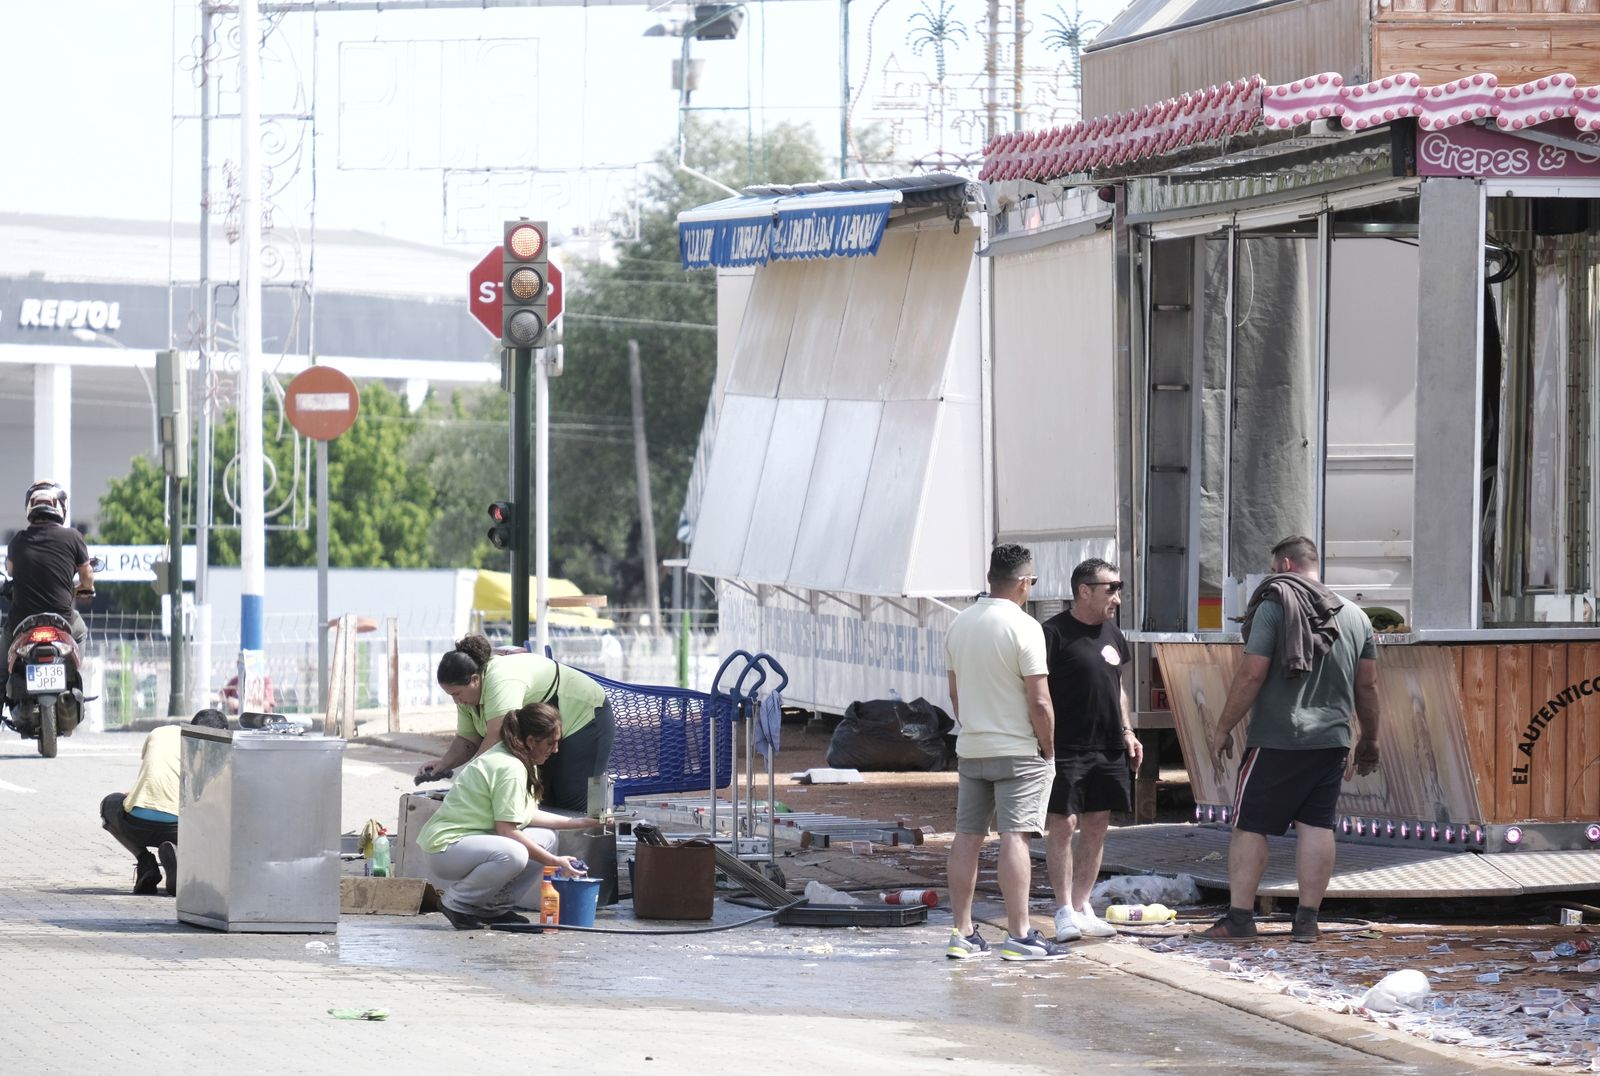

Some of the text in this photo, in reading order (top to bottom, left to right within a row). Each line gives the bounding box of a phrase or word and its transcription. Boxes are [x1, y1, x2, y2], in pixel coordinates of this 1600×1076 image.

[1421, 133, 1530, 175] Crepes
[1537, 143, 1567, 171] &
[20, 299, 121, 329] REPSOL
[868, 621, 919, 674] SUPREMA
[35, 666, 63, 677] 5136
[37, 677, 57, 688] JPP
[1512, 763, 1530, 785] EL
